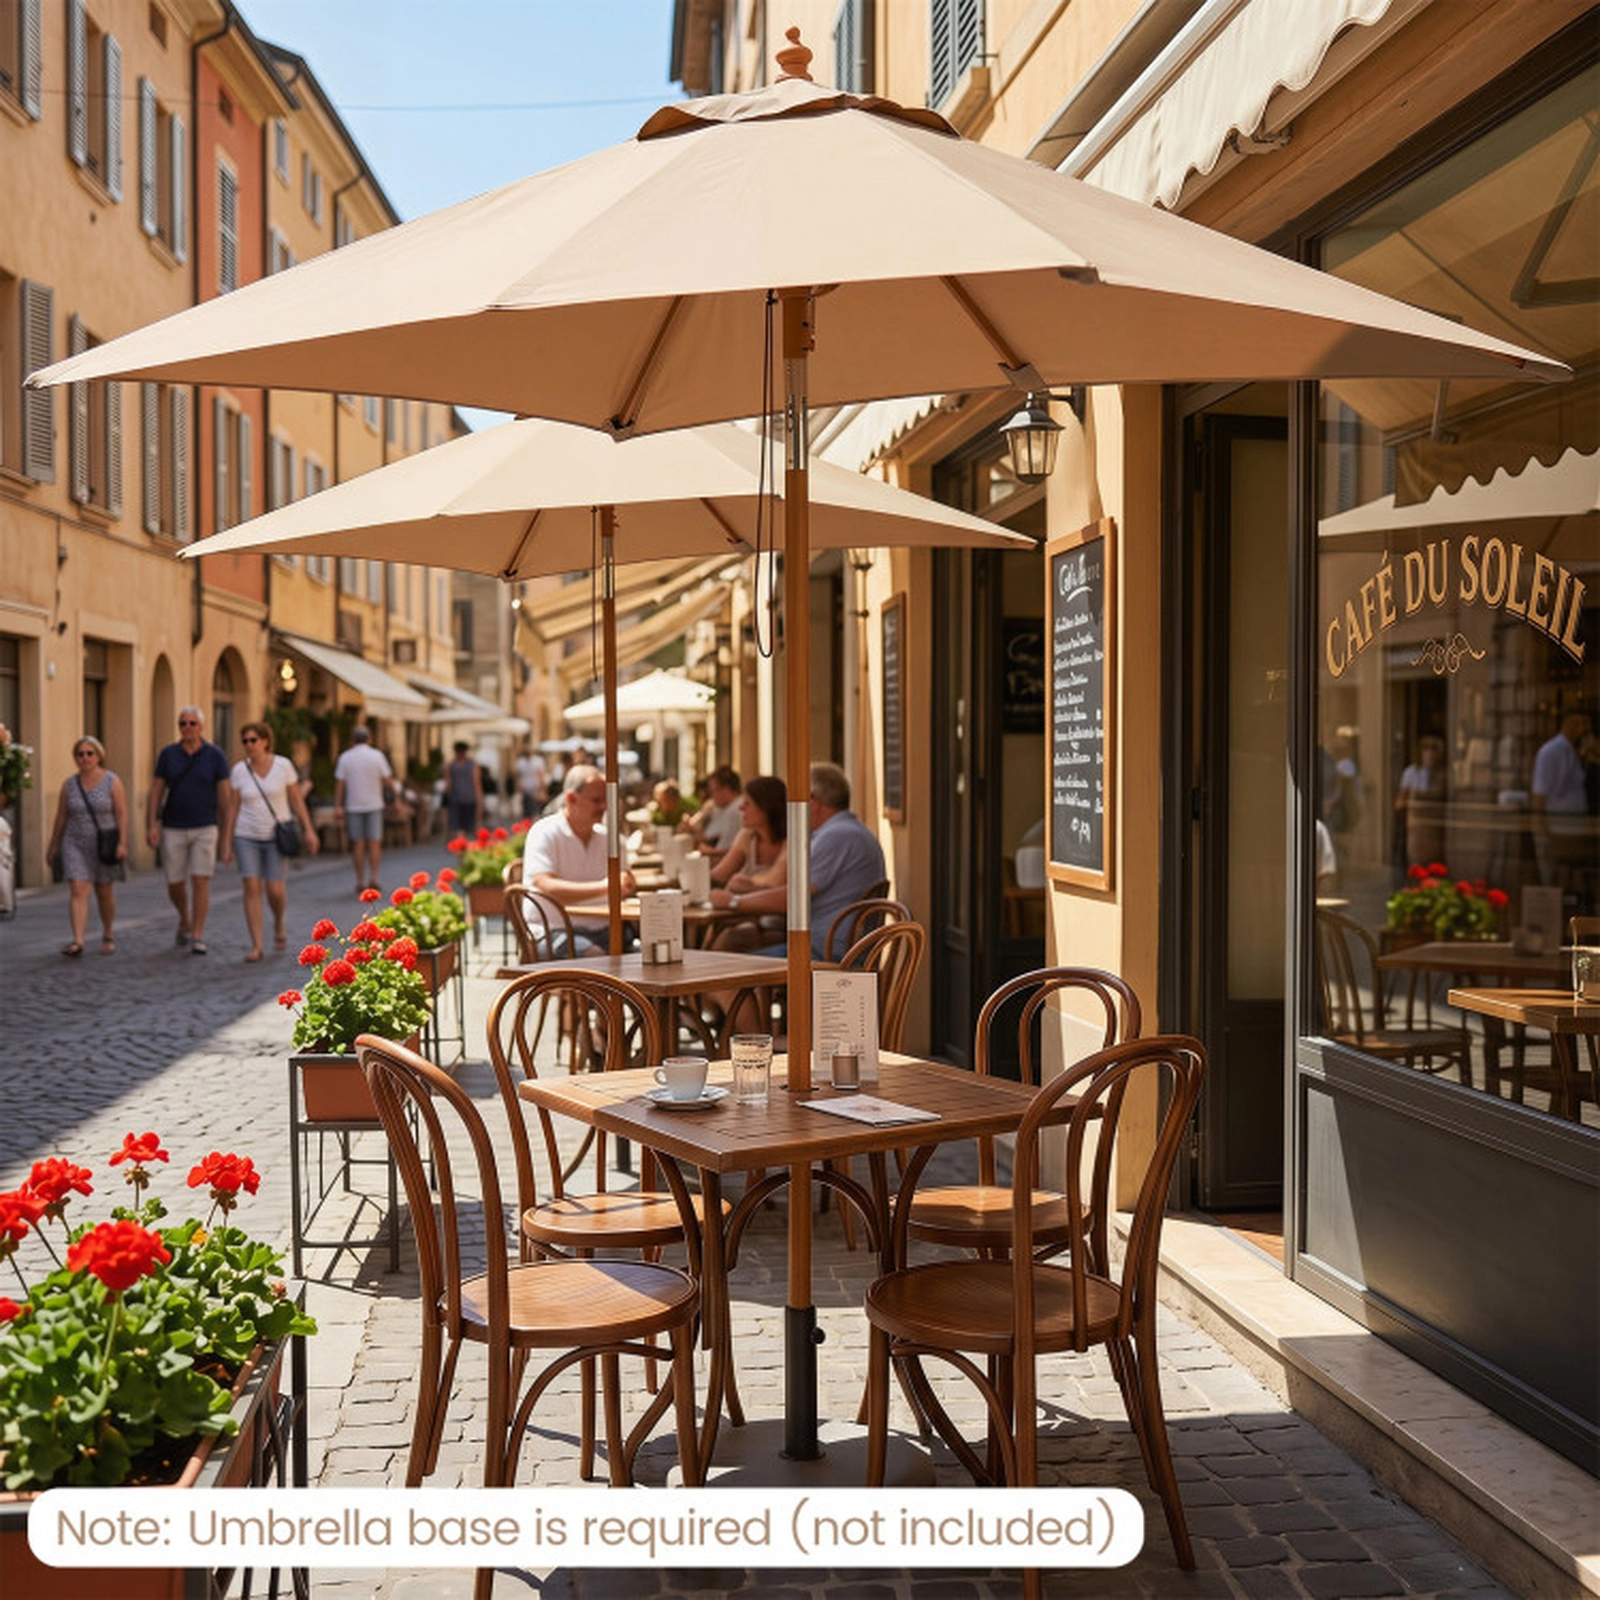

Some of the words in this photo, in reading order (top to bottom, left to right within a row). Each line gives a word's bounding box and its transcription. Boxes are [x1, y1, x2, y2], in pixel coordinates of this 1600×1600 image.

[1326, 550, 1397, 677] CAFÉ
[1403, 539, 1449, 615] DU
[1459, 534, 1587, 661] SOLEIL
